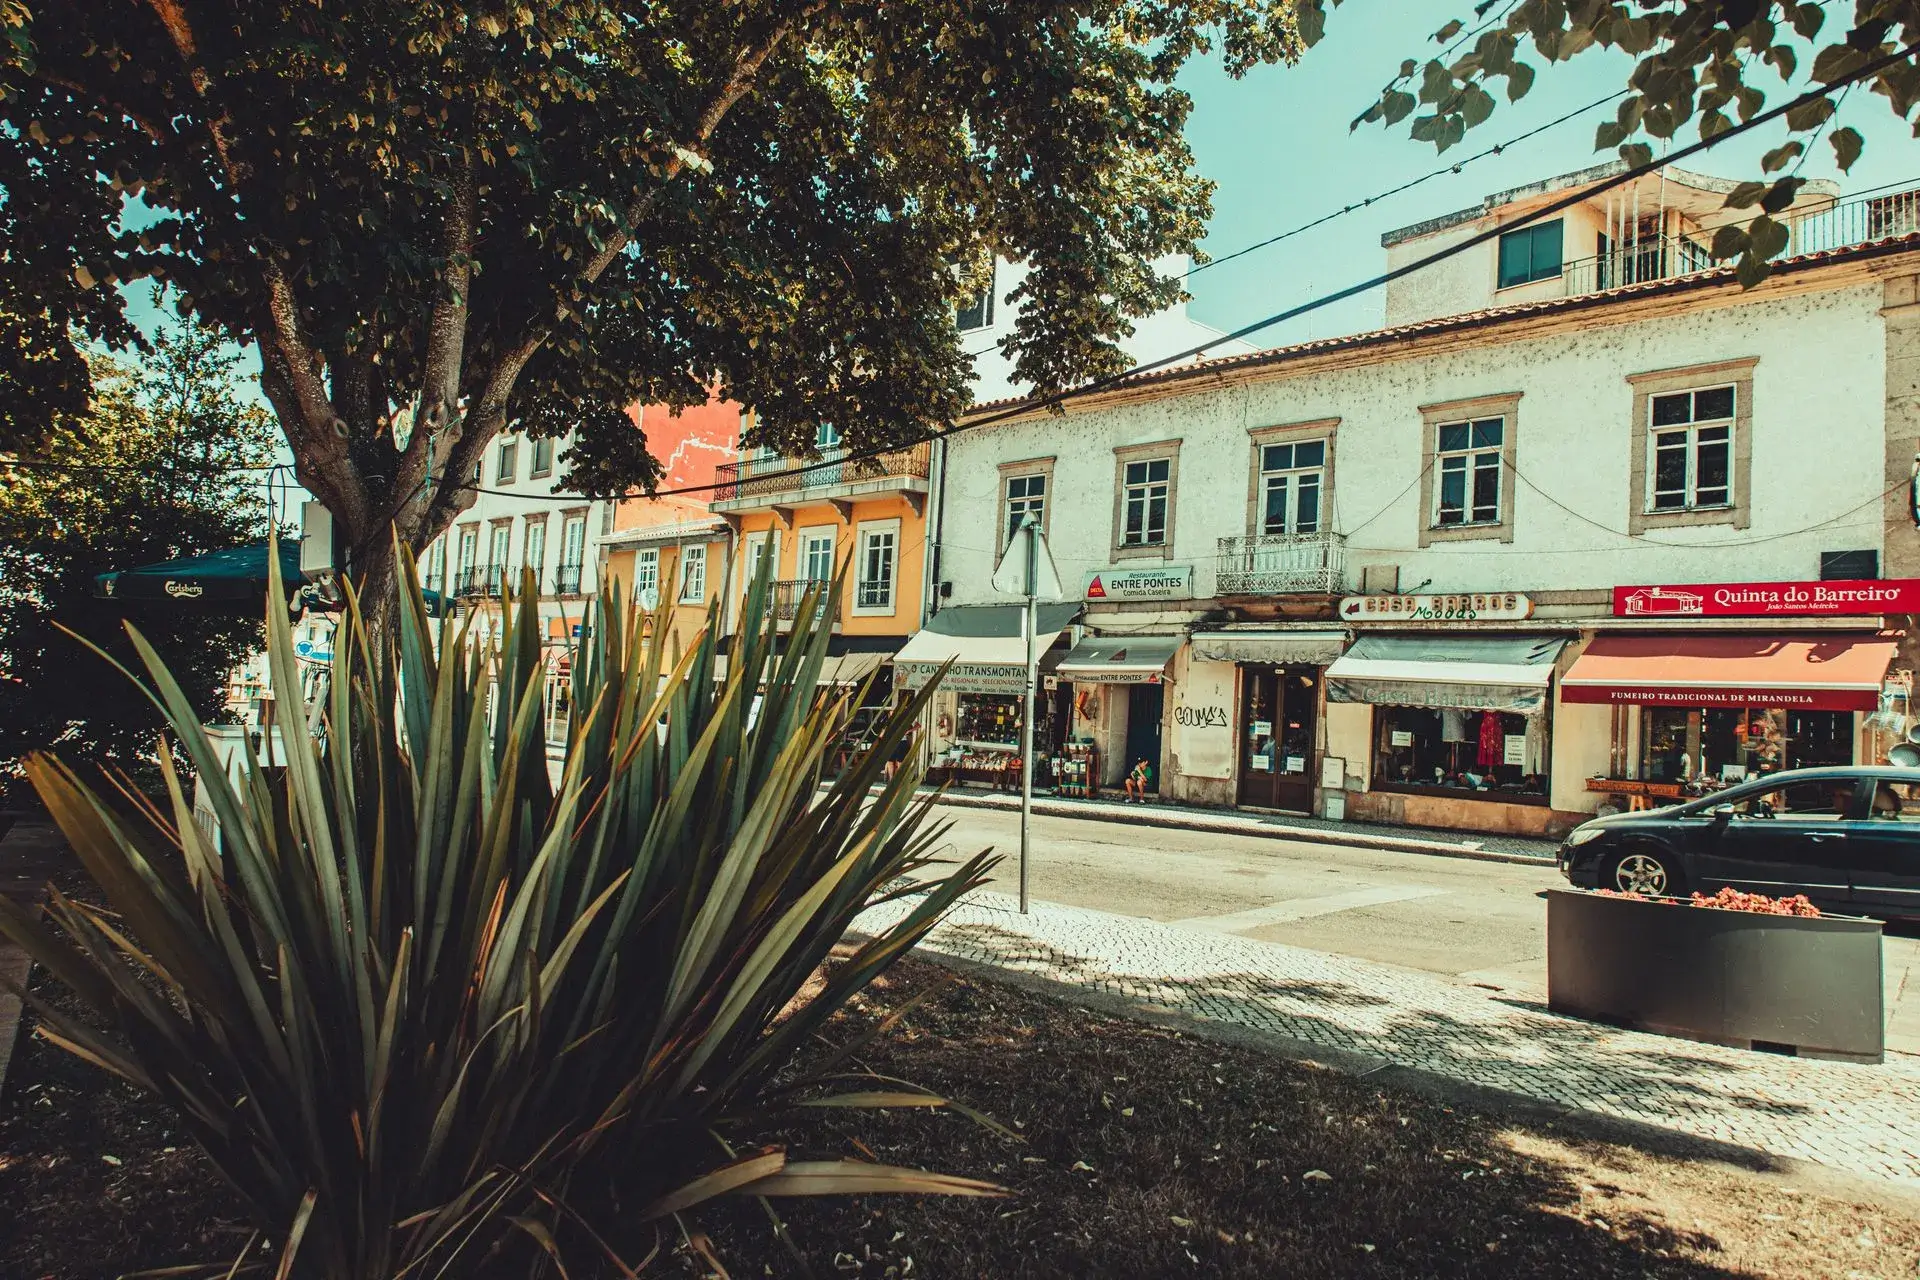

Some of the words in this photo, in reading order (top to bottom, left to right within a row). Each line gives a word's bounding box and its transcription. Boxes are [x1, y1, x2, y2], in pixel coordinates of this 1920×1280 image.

[1128, 571, 1167, 579] Restaurante
[165, 580, 203, 598] Carlsberg
[1111, 579, 1141, 589] ENTRE
[1143, 577, 1182, 588] PONTES
[1123, 588, 1147, 597] Comida
[1147, 588, 1171, 596] Caseira
[1714, 588, 1780, 607] Quinta
[1783, 586, 1809, 602] do
[1814, 585, 1898, 602] Barreiro
[1365, 597, 1417, 612] CASA
[1432, 595, 1517, 611] BARROS
[1766, 602, 1783, 611] João
[1784, 602, 1807, 610] Santos
[1808, 601, 1839, 610] Meireles
[1410, 606, 1477, 620] Modas
[982, 678, 1023, 686] SELECIONADOS
[1362, 686, 1410, 702] Casa
[1611, 692, 1655, 700] FUMEIRO
[1658, 693, 1728, 701] TRADICIONAL
[1748, 694, 1813, 703] MIRANDELA
